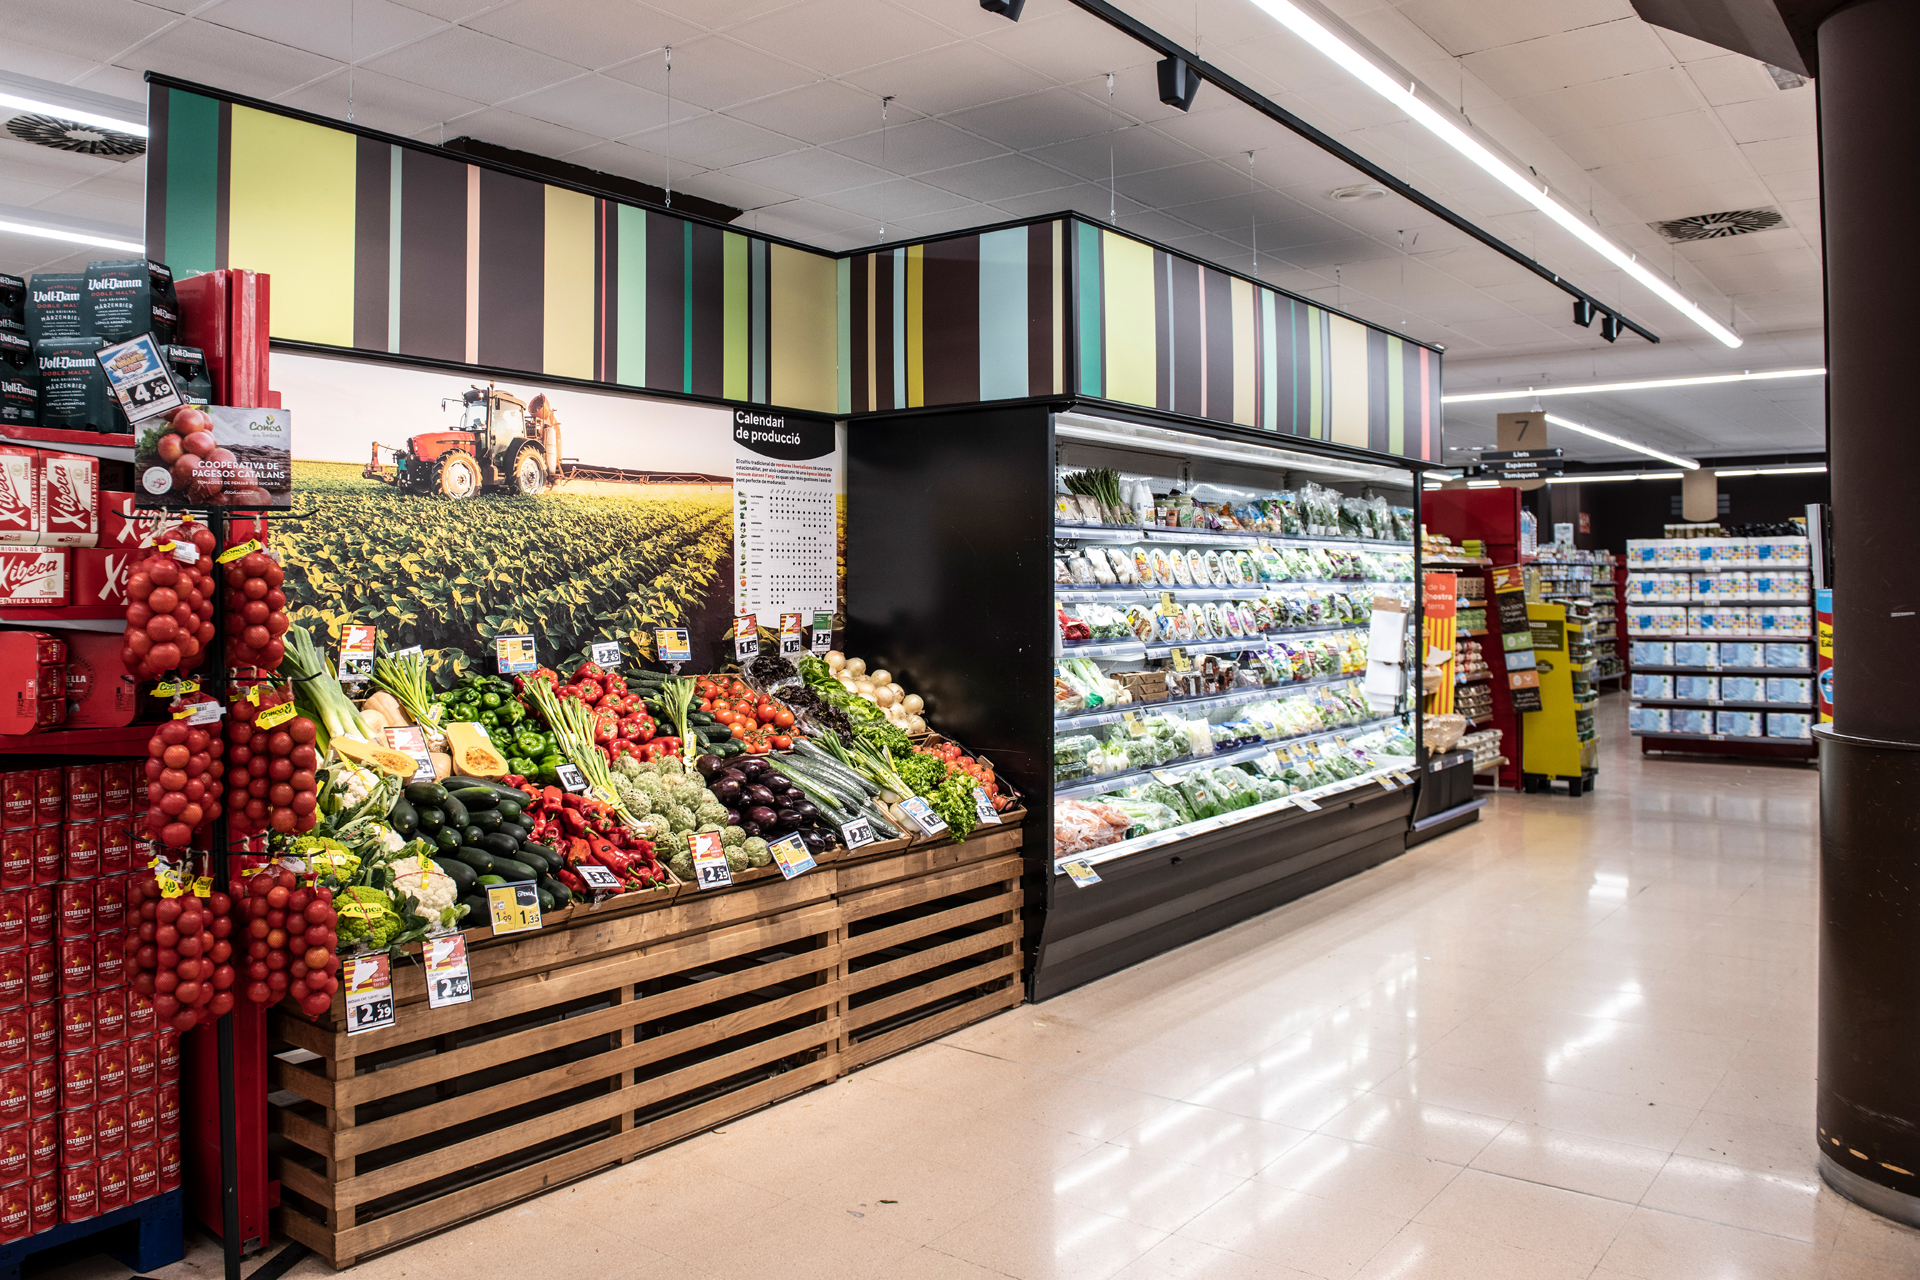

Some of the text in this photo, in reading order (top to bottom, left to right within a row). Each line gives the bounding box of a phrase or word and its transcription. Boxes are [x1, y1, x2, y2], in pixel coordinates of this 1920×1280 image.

[88, 278, 143, 291] Voll-Damm
[169, 347, 202, 360] Voll-Damm
[38, 356, 96, 369] Voll-Damm
[135, 384, 170, 402] 4,49
[736, 411, 784, 428] Calendari
[249, 422, 282, 432] Conca
[1515, 420, 1529, 442] 7
[736, 427, 801, 445] de producció
[198, 461, 264, 470] COOPERATIVA
[192, 470, 285, 479] PAGESOS CATALANS
[50, 464, 88, 530] Xibeca
[0, 556, 58, 592] Xibeca
[602, 650, 619, 662] 2,65
[260, 706, 284, 720] Conca
[71, 850, 97, 858] ESTRELLA
[104, 845, 128, 853] ESTRELLA
[4, 859, 30, 867] ESTRELLA
[706, 867, 728, 882] 2,25
[65, 908, 90, 916] ESTRELLA
[98, 903, 122, 911] ESTRELLA
[496, 911, 512, 922] 1,99
[520, 910, 539, 925] 1,35
[0, 919, 23, 928] STRELLA
[99, 959, 122, 968] ESTRELLA
[65, 965, 91, 974] ESTRELLA
[0, 978, 23, 987] STRELLA
[441, 979, 468, 997] 2,49
[131, 1008, 153, 1017] ESTRELLA
[361, 1003, 392, 1022] 2,29
[100, 1014, 123, 1024] ESTRELLA
[66, 1021, 92, 1031] ESTRELLA
[132, 1063, 154, 1072] ESTRELLA
[100, 1070, 124, 1081] ESTRELLA
[67, 1078, 93, 1088] ESTRELLA
[131, 1117, 154, 1128] ESTRELLA
[100, 1125, 124, 1136] ESTRELLA
[67, 1134, 92, 1145] ESTRELLA
[133, 1170, 156, 1182] ESTRELLA
[102, 1180, 126, 1192] ESTRELLA
[69, 1190, 94, 1201] ESTRELLA
[1, 1210, 27, 1222] ESTRELLA
